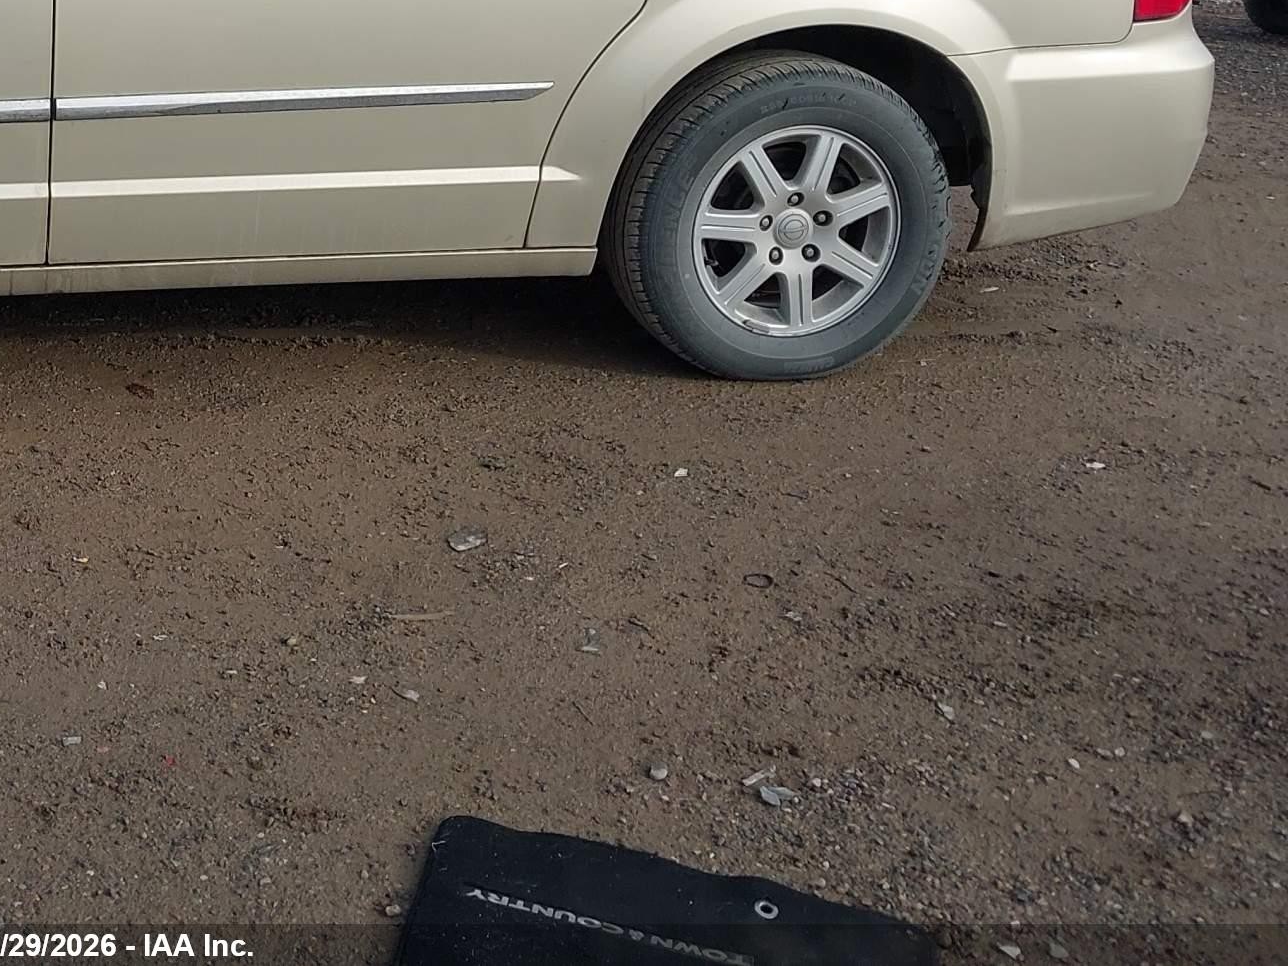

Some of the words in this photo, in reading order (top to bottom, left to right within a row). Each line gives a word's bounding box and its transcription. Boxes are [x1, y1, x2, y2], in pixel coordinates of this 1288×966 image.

[466, 889, 624, 934] COUNTRY
[628, 929, 645, 941] &
[650, 935, 754, 966] TOWN
